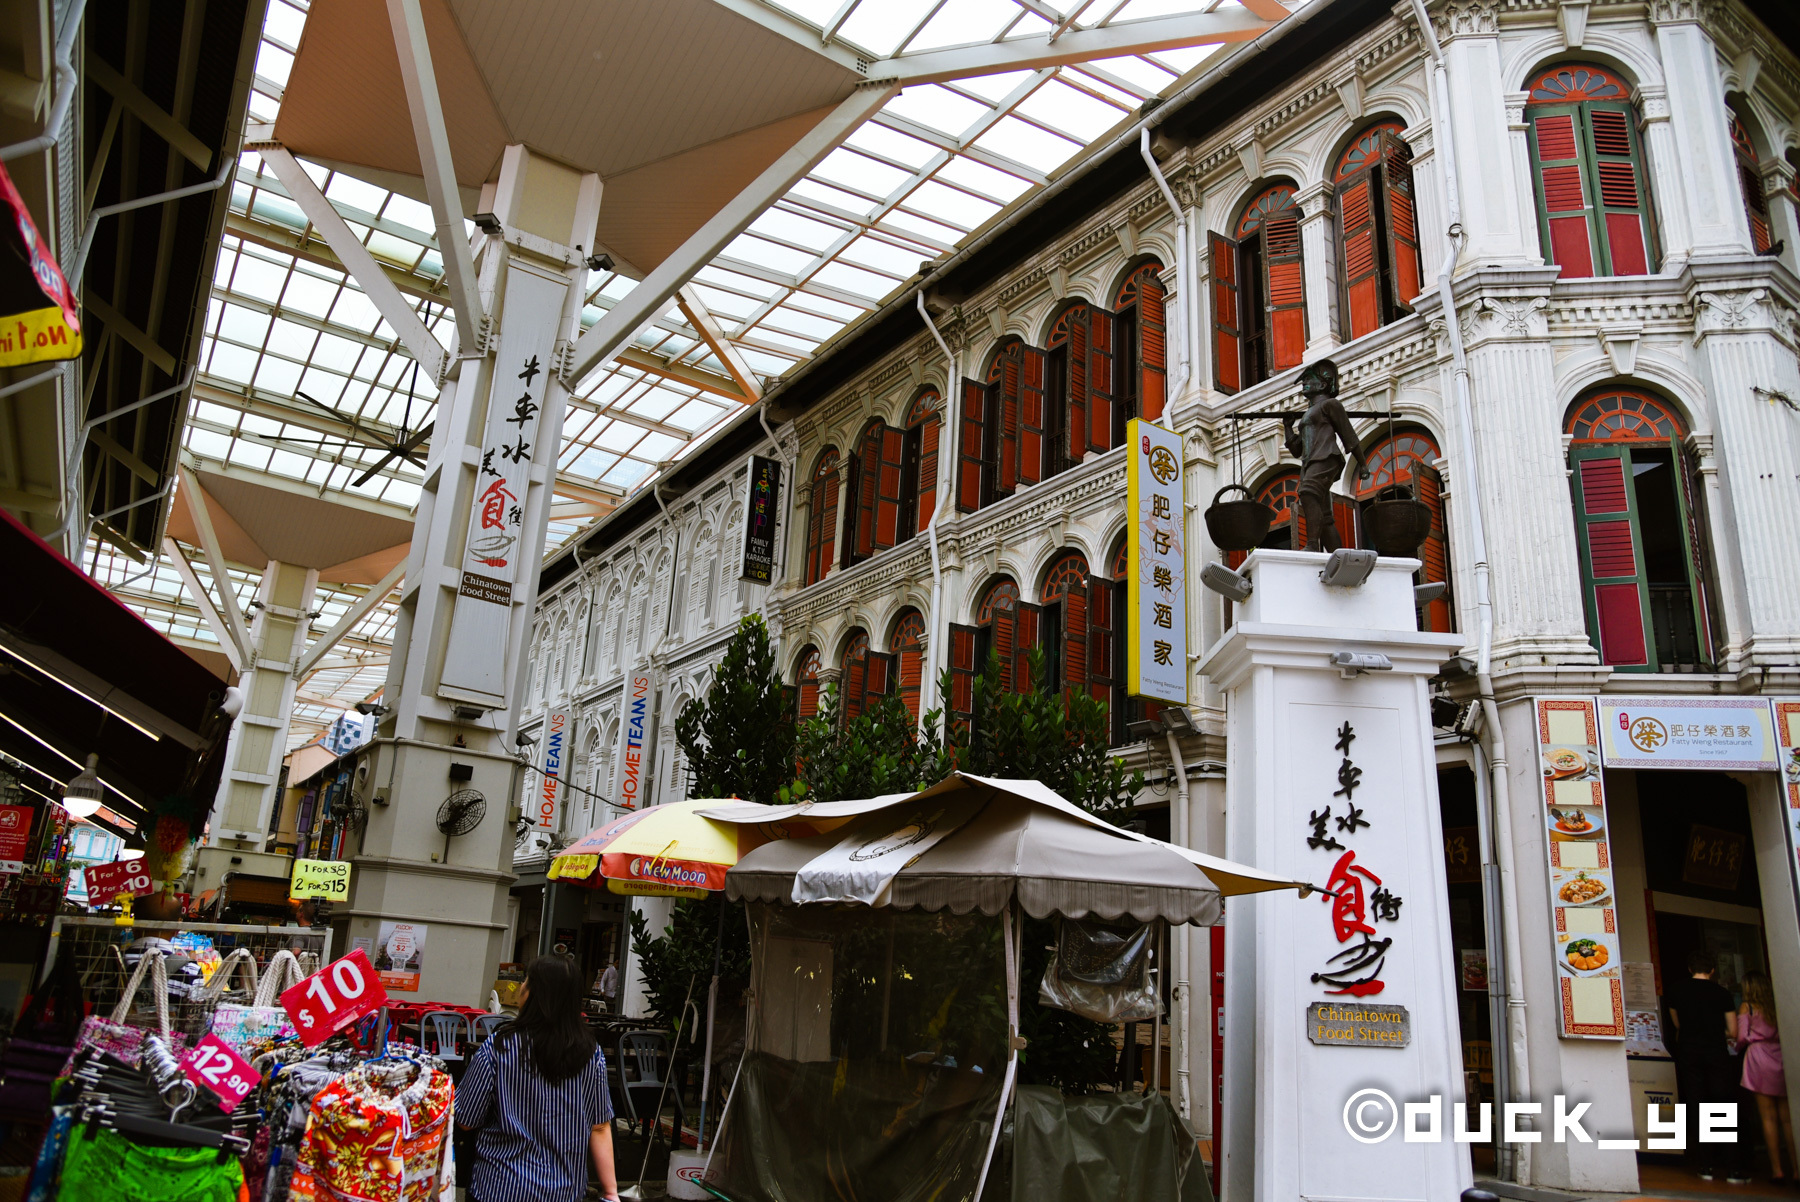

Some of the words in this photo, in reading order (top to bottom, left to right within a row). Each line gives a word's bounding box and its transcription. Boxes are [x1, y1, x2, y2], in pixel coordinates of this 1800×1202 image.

[750, 536, 769, 548] FAMILY
[746, 552, 771, 565] KARAOKE
[463, 574, 511, 594] Chinatown
[1152, 493, 1173, 667] 肥仔榮酒家
[461, 584, 484, 597] Food
[485, 589, 511, 605] Street
[1164, 681, 1185, 691] Restaurant
[1620, 714, 1629, 730] 肥仔
[1634, 721, 1664, 749] 榮
[1670, 723, 1752, 738] 肥仔榮酒家
[1671, 738, 1690, 746] Fatty
[1691, 738, 1712, 747] Weng
[1713, 738, 1752, 746] Restaurant
[88, 869, 97, 882] 1
[100, 872, 114, 880] For
[304, 864, 309, 873] 1
[312, 866, 328, 874] FOR
[89, 886, 100, 899] 2
[103, 885, 116, 893] For
[119, 875, 149, 891] $10
[295, 878, 304, 891] 2
[299, 959, 365, 1029] $10
[1317, 1006, 1402, 1023] Chinatown
[1317, 1024, 1355, 1041] Food
[1359, 1025, 1403, 1042] Street
[188, 1045, 250, 1096] $12.90
[1648, 1096, 1671, 1105] VISA
